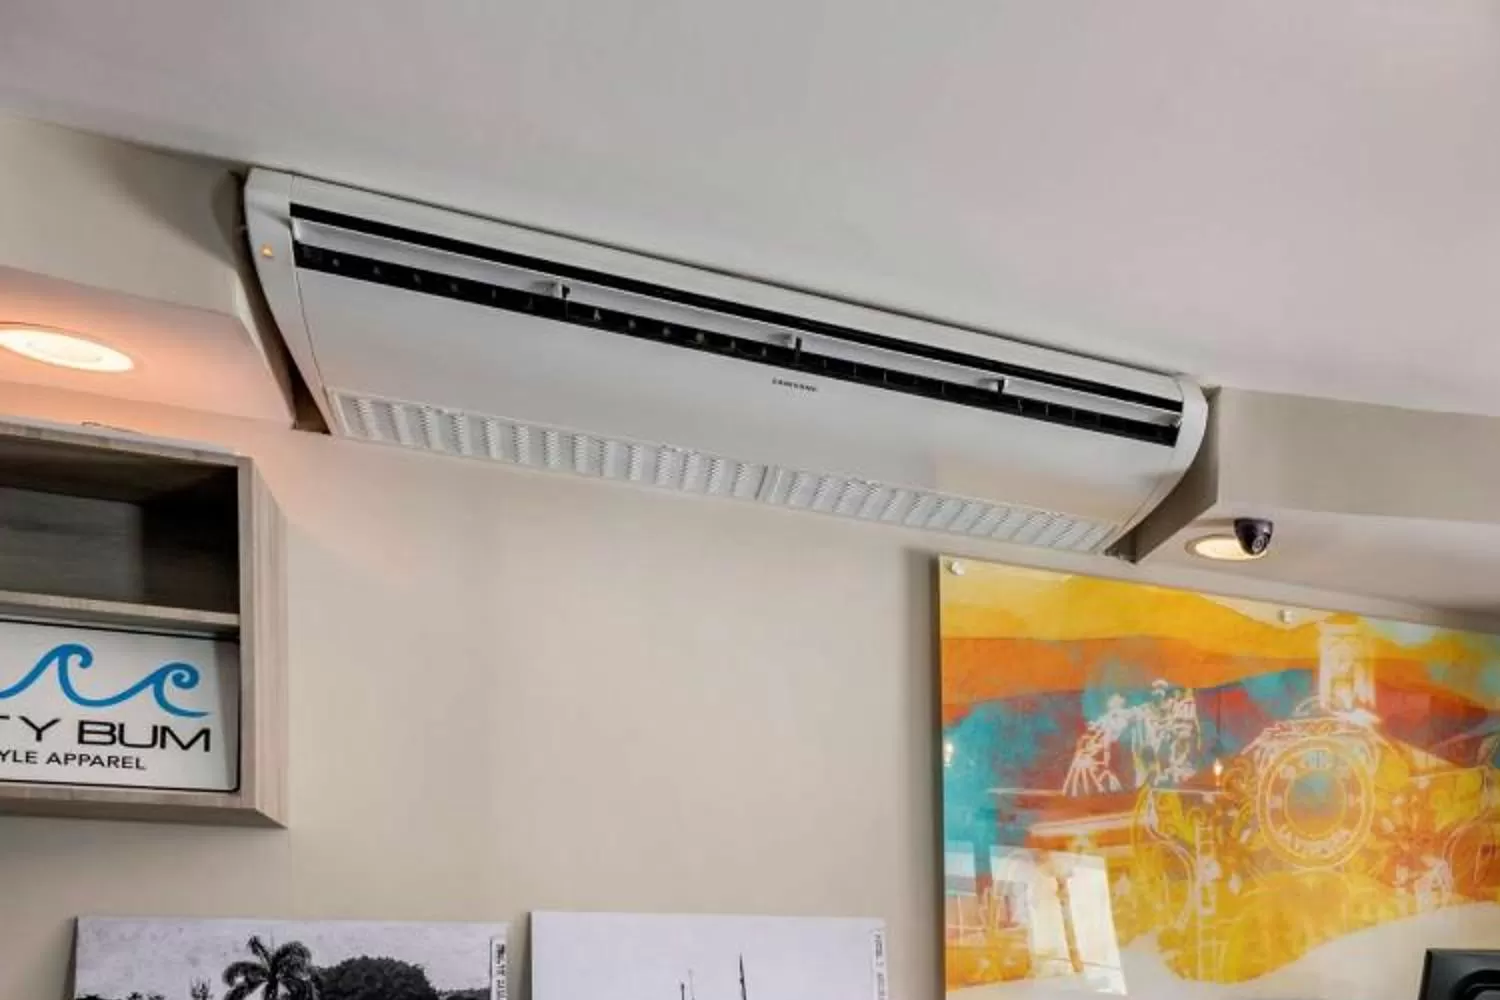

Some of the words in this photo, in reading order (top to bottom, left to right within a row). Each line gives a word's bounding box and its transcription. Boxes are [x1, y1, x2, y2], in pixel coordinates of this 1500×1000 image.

[0, 715, 61, 742] Y
[78, 719, 211, 752] BUM
[46, 752, 147, 770] APPAREL
